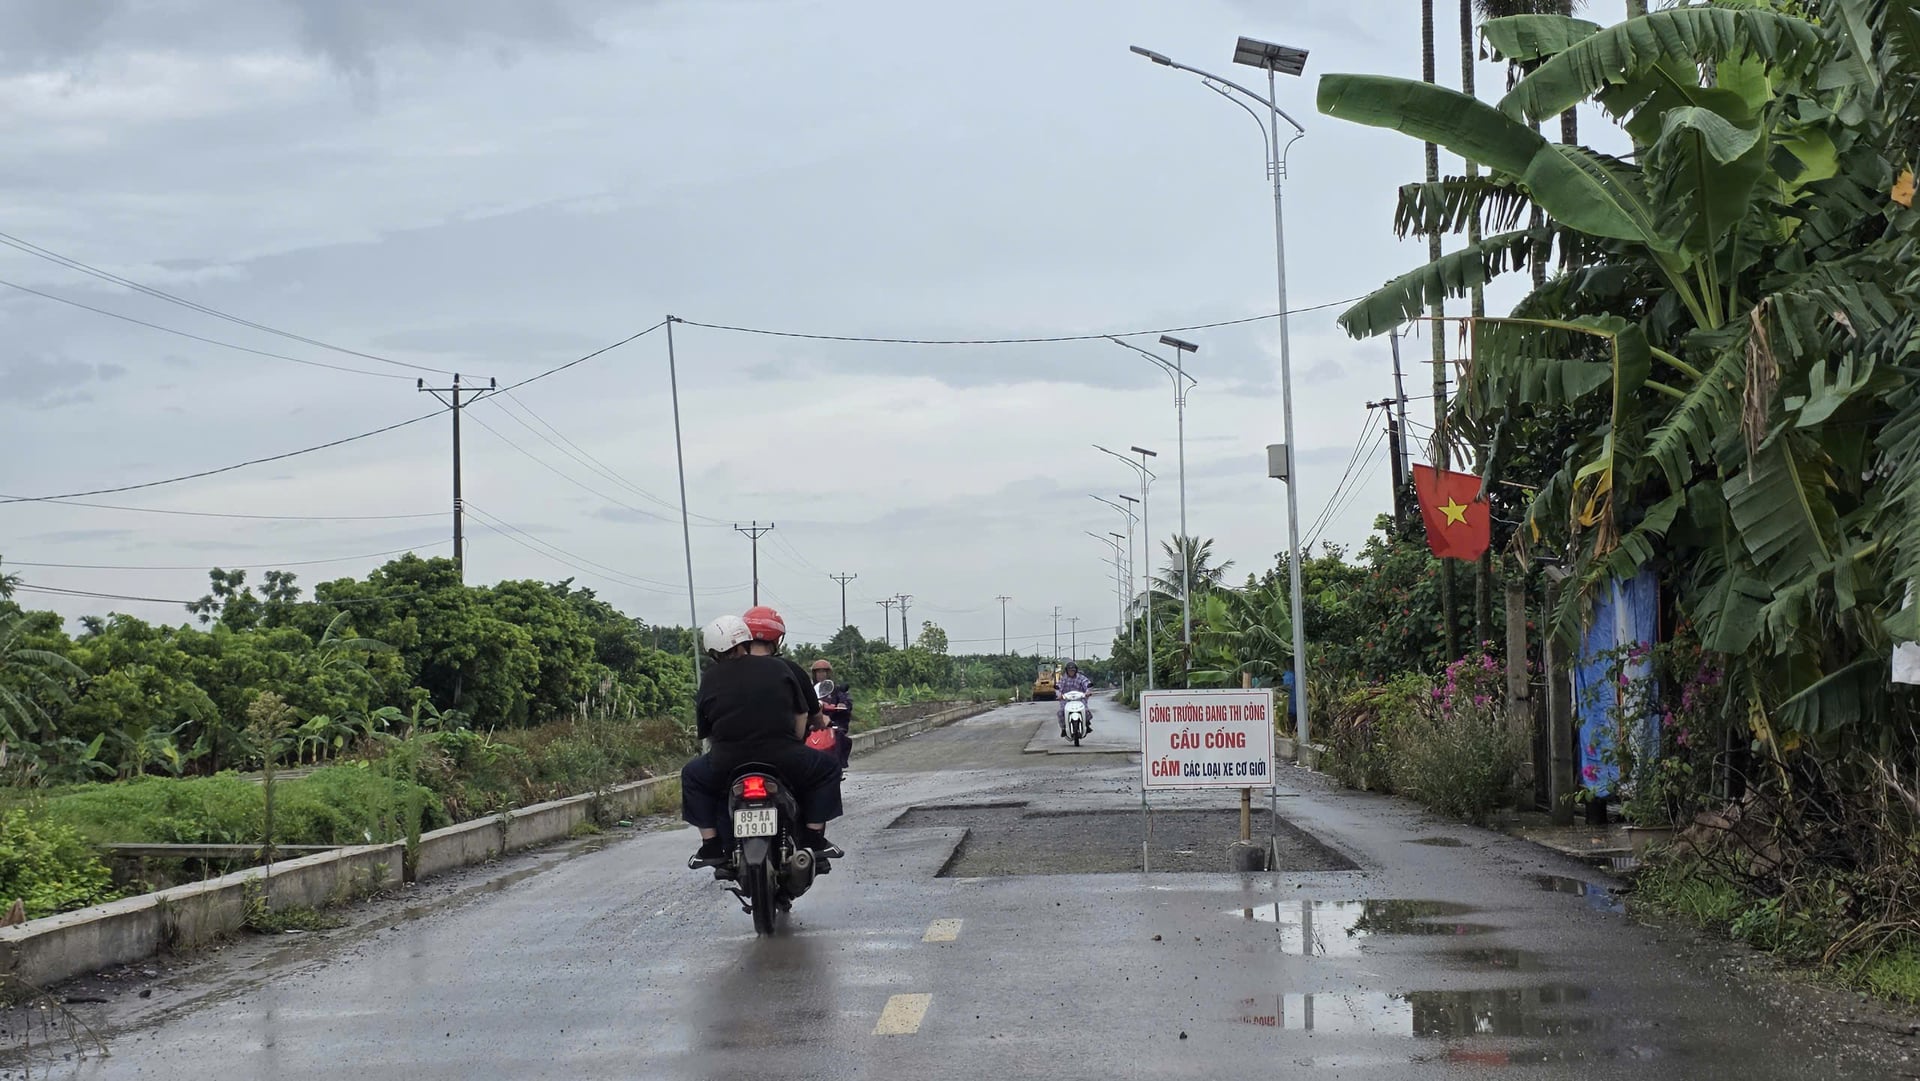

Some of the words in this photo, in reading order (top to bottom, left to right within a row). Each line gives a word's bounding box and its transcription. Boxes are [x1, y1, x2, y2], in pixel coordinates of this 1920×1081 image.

[1149, 703, 1171, 723] CÔNG
[1205, 704, 1227, 721] ĐANG
[1229, 704, 1242, 721] THI
[1243, 701, 1265, 721] CÔNG
[1170, 727, 1200, 750] CẦU
[1204, 726, 1246, 749] CỐNG
[1151, 754, 1181, 777] CẤM
[1183, 760, 1201, 777] CÁC
[1202, 762, 1221, 780] LOẠI
[1223, 762, 1234, 777] XE
[1235, 760, 1248, 777] CƠ
[1249, 758, 1266, 776] GIỚI
[740, 811, 770, 823] 89-AA
[736, 822, 774, 836] 819.01
